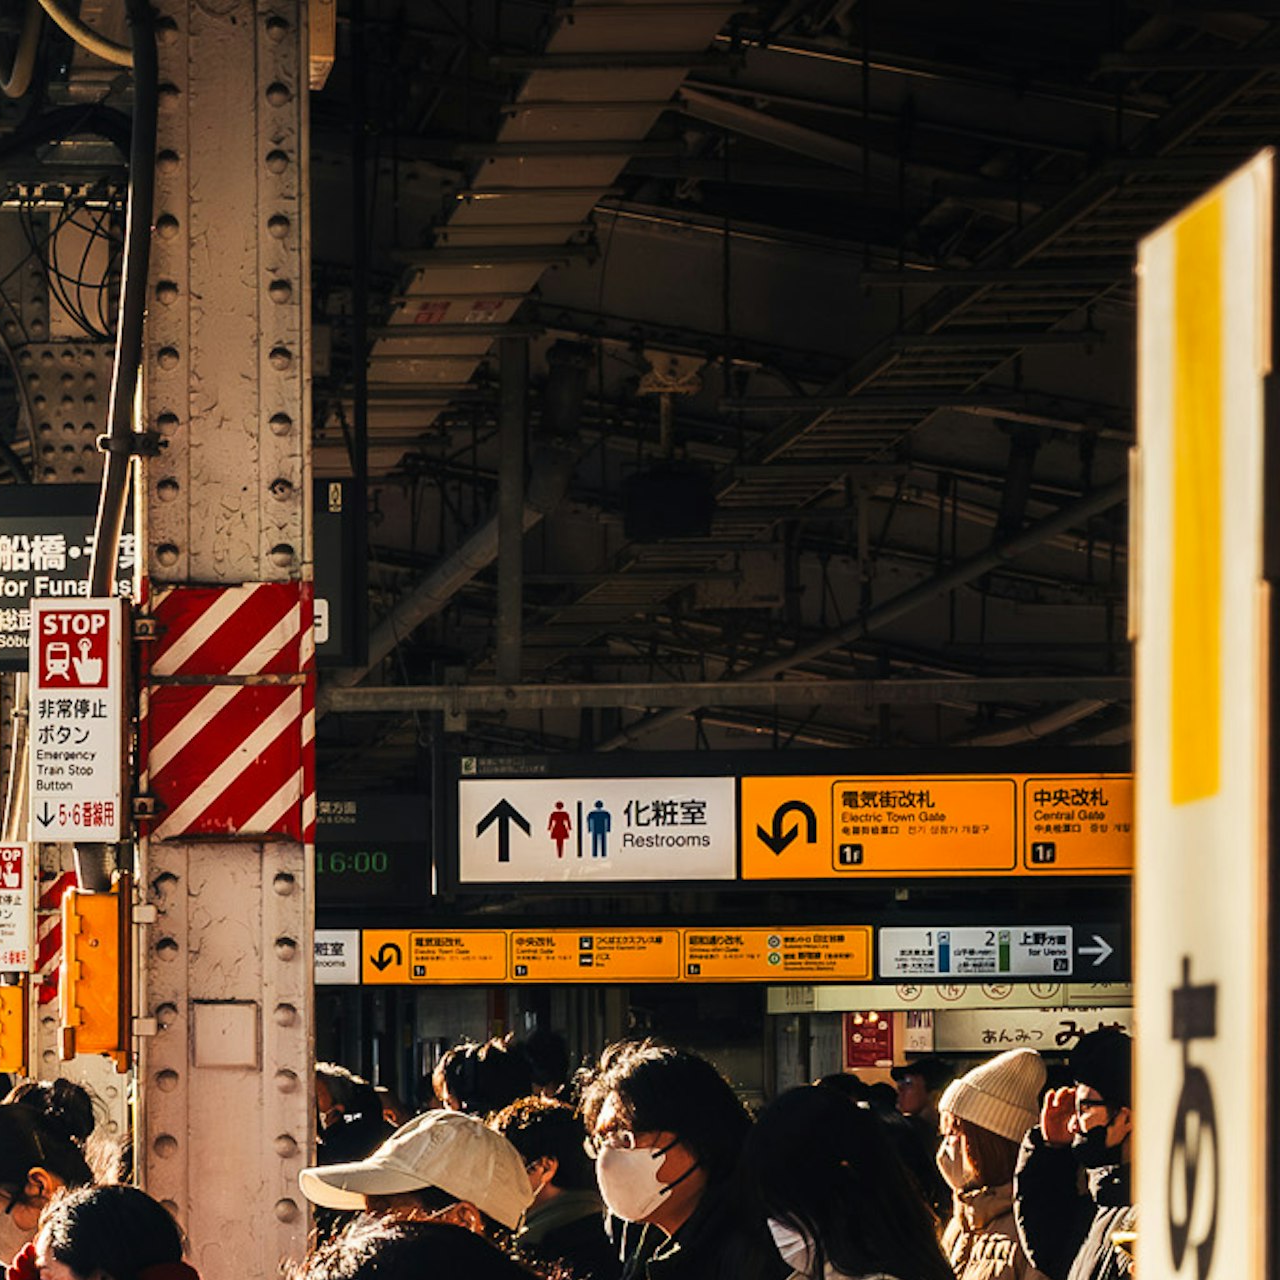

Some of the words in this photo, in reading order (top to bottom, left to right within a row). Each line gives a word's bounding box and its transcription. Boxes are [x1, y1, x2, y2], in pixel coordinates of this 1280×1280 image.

[43, 614, 106, 635] STOP
[39, 699, 107, 719] 非常停止
[39, 726, 90, 745] ボタン
[37, 750, 97, 764] Emergency
[37, 765, 64, 776] Train
[69, 765, 94, 779] Stop
[37, 781, 73, 792] Button
[842, 790, 935, 810] 電気街改札
[1034, 789, 1109, 807] 中央改札
[59, 802, 115, 828] 5・6番線用
[624, 800, 708, 828] 化粧室
[842, 811, 882, 823] Electric
[886, 811, 916, 823] Town
[919, 811, 947, 823] Gate
[1034, 810, 1075, 822] Central
[1078, 810, 1106, 822] Gate
[623, 834, 711, 848] Restrooms
[926, 932, 933, 947] 1
[985, 931, 996, 947] 2
[1044, 948, 1067, 957] Ueno
[981, 1029, 1044, 1045] あんみつ
